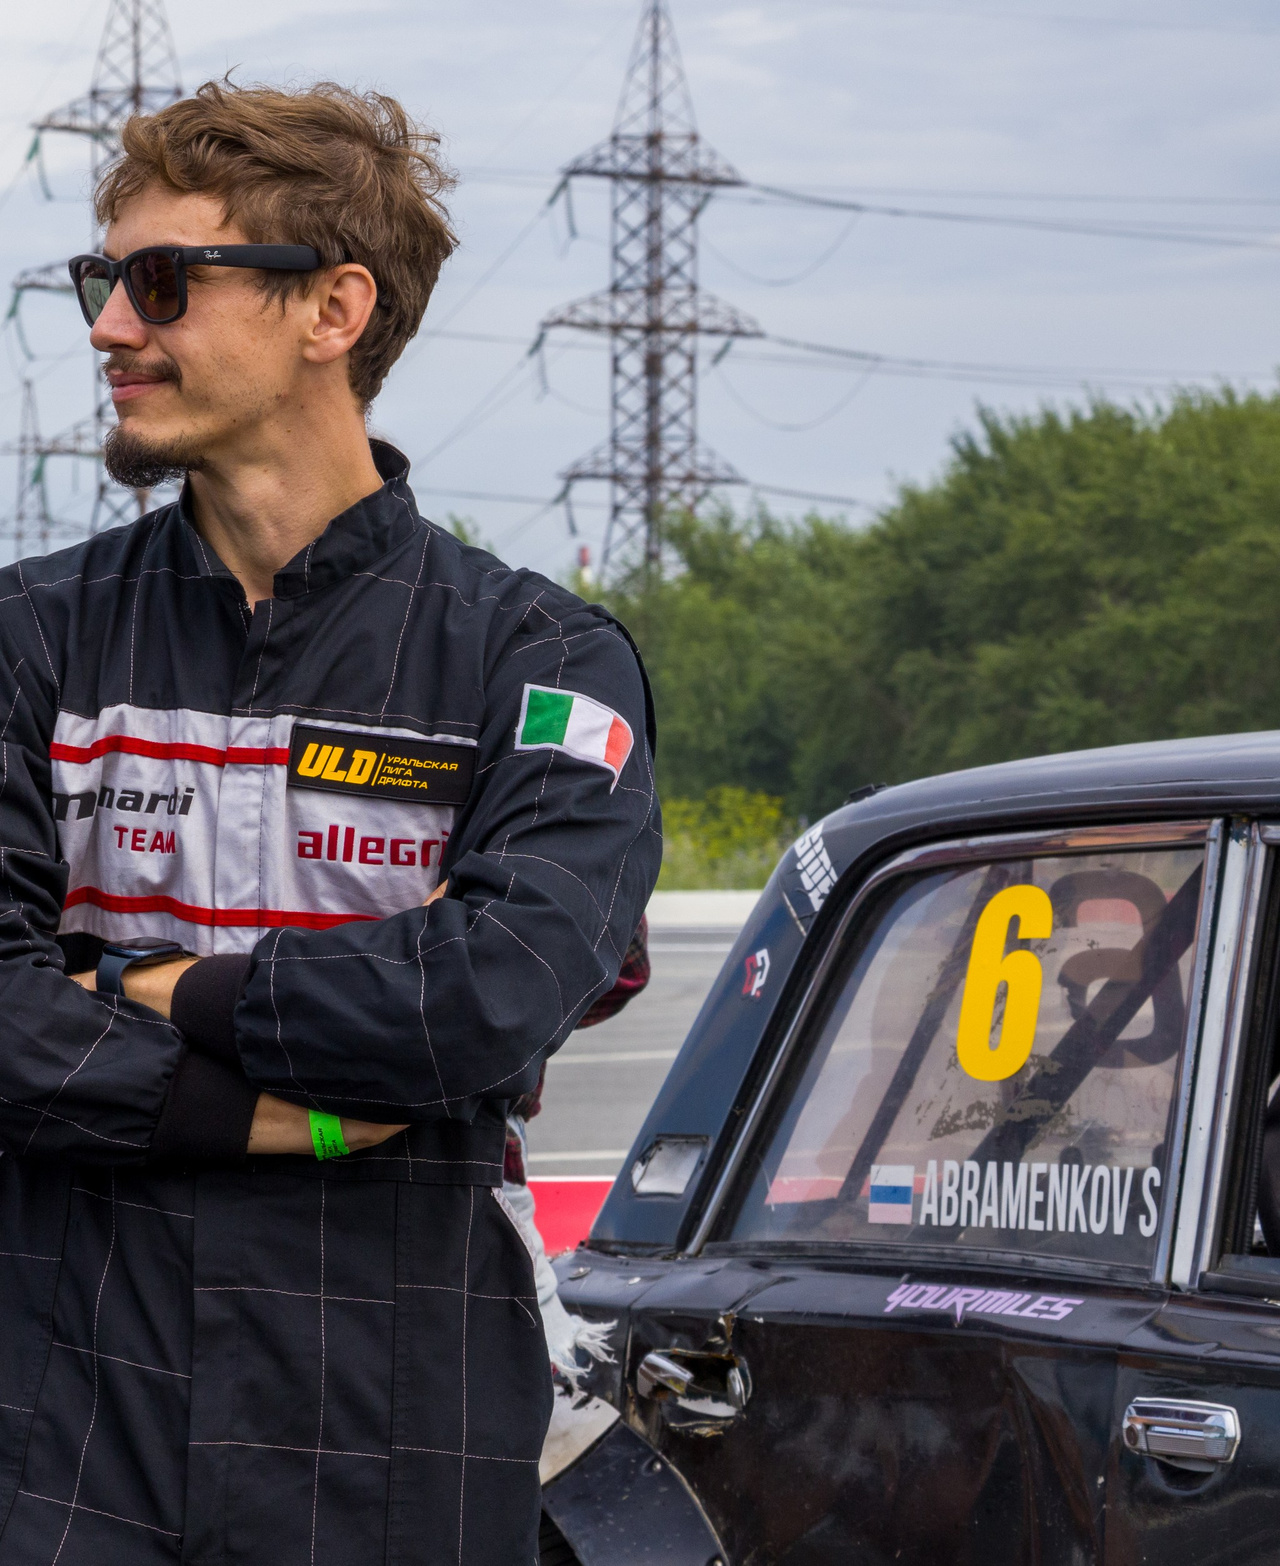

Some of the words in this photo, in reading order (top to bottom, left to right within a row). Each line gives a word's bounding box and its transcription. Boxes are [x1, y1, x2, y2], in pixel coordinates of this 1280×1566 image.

[297, 742, 377, 785] ULD
[382, 765, 413, 777] ЛИГА
[386, 755, 459, 772] УРАЛЬСКАЯ
[377, 776, 428, 789] ДРИФТА
[113, 825, 177, 854] TEAM
[956, 884, 1053, 1081] 6
[919, 1159, 1134, 1236] ABRAMENKOV
[1138, 1165, 1162, 1238] S
